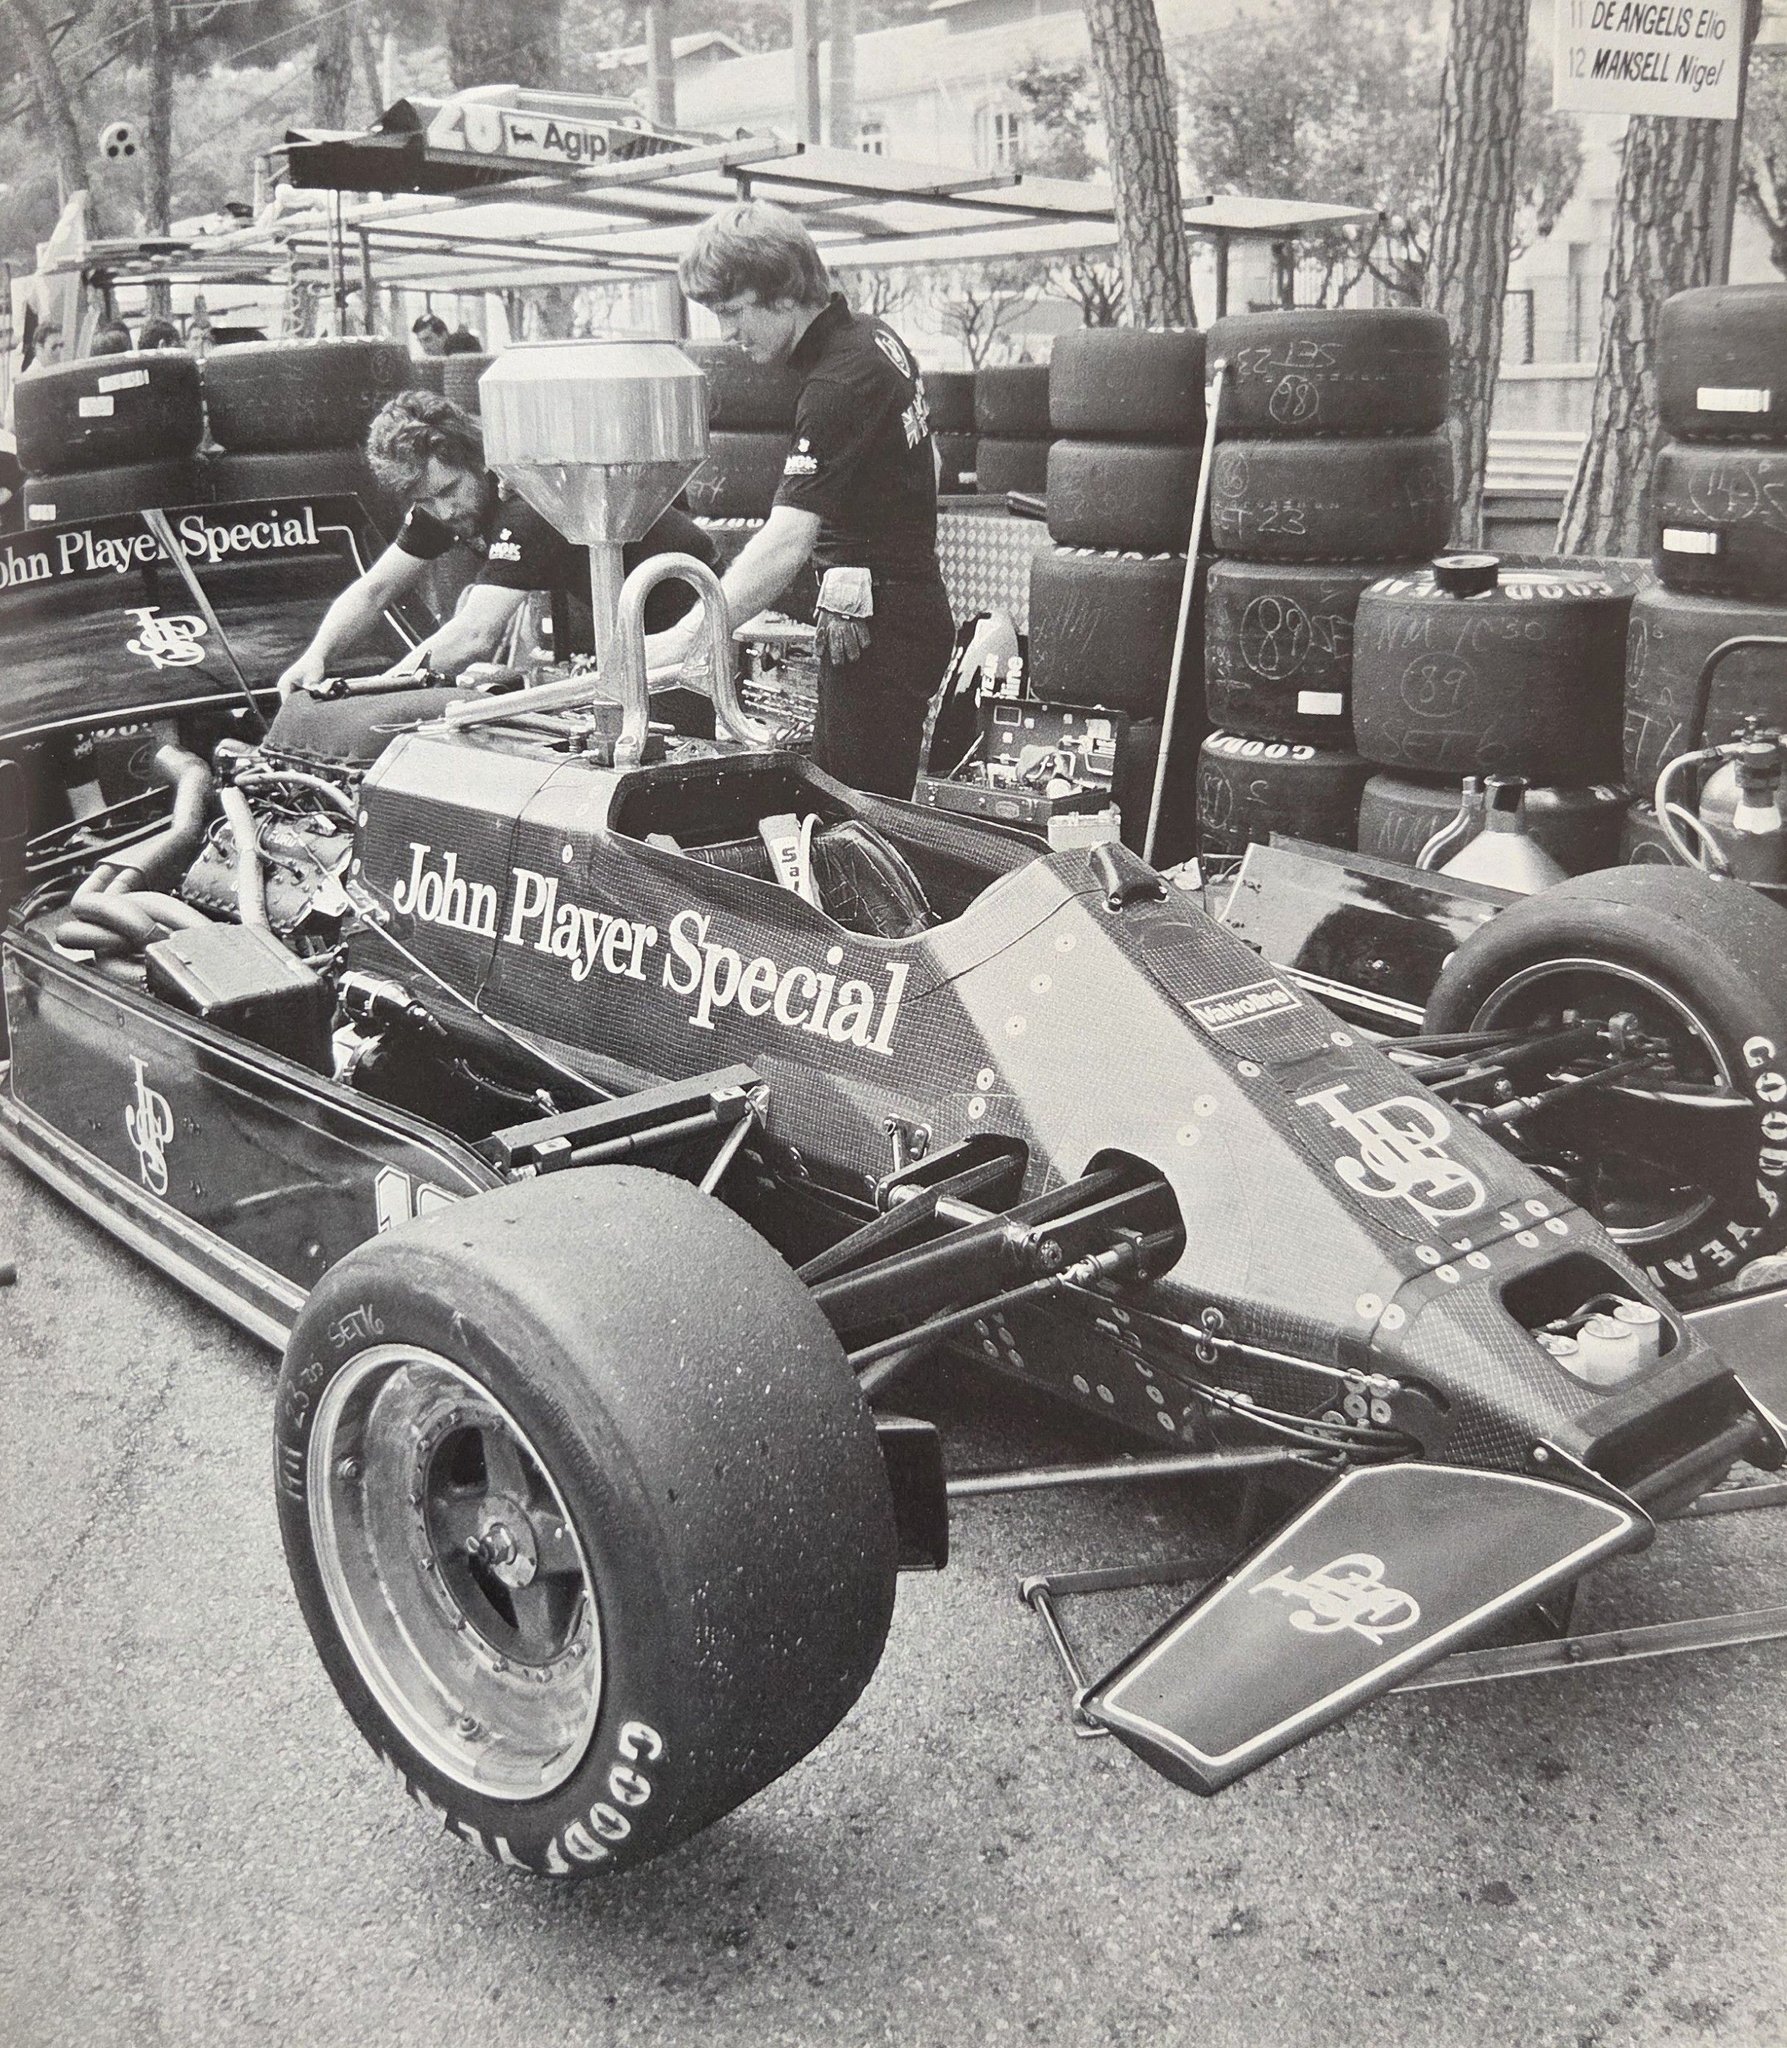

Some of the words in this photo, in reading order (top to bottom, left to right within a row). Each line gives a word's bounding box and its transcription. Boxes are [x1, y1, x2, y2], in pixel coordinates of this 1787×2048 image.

[1590, 0, 1616, 31] DE
[1615, 3, 1693, 38] ANGELIS
[1694, 9, 1727, 41] Elio
[1569, 47, 1586, 79] 12
[1590, 47, 1670, 83] MANSELL
[1674, 53, 1726, 94] Nigel
[543, 122, 609, 162] Agip
[178, 505, 321, 564] Special
[393, 842, 498, 938] John
[502, 867, 658, 981] Player
[662, 909, 910, 1056] Special
[1195, 989, 1291, 1024] Valvoline
